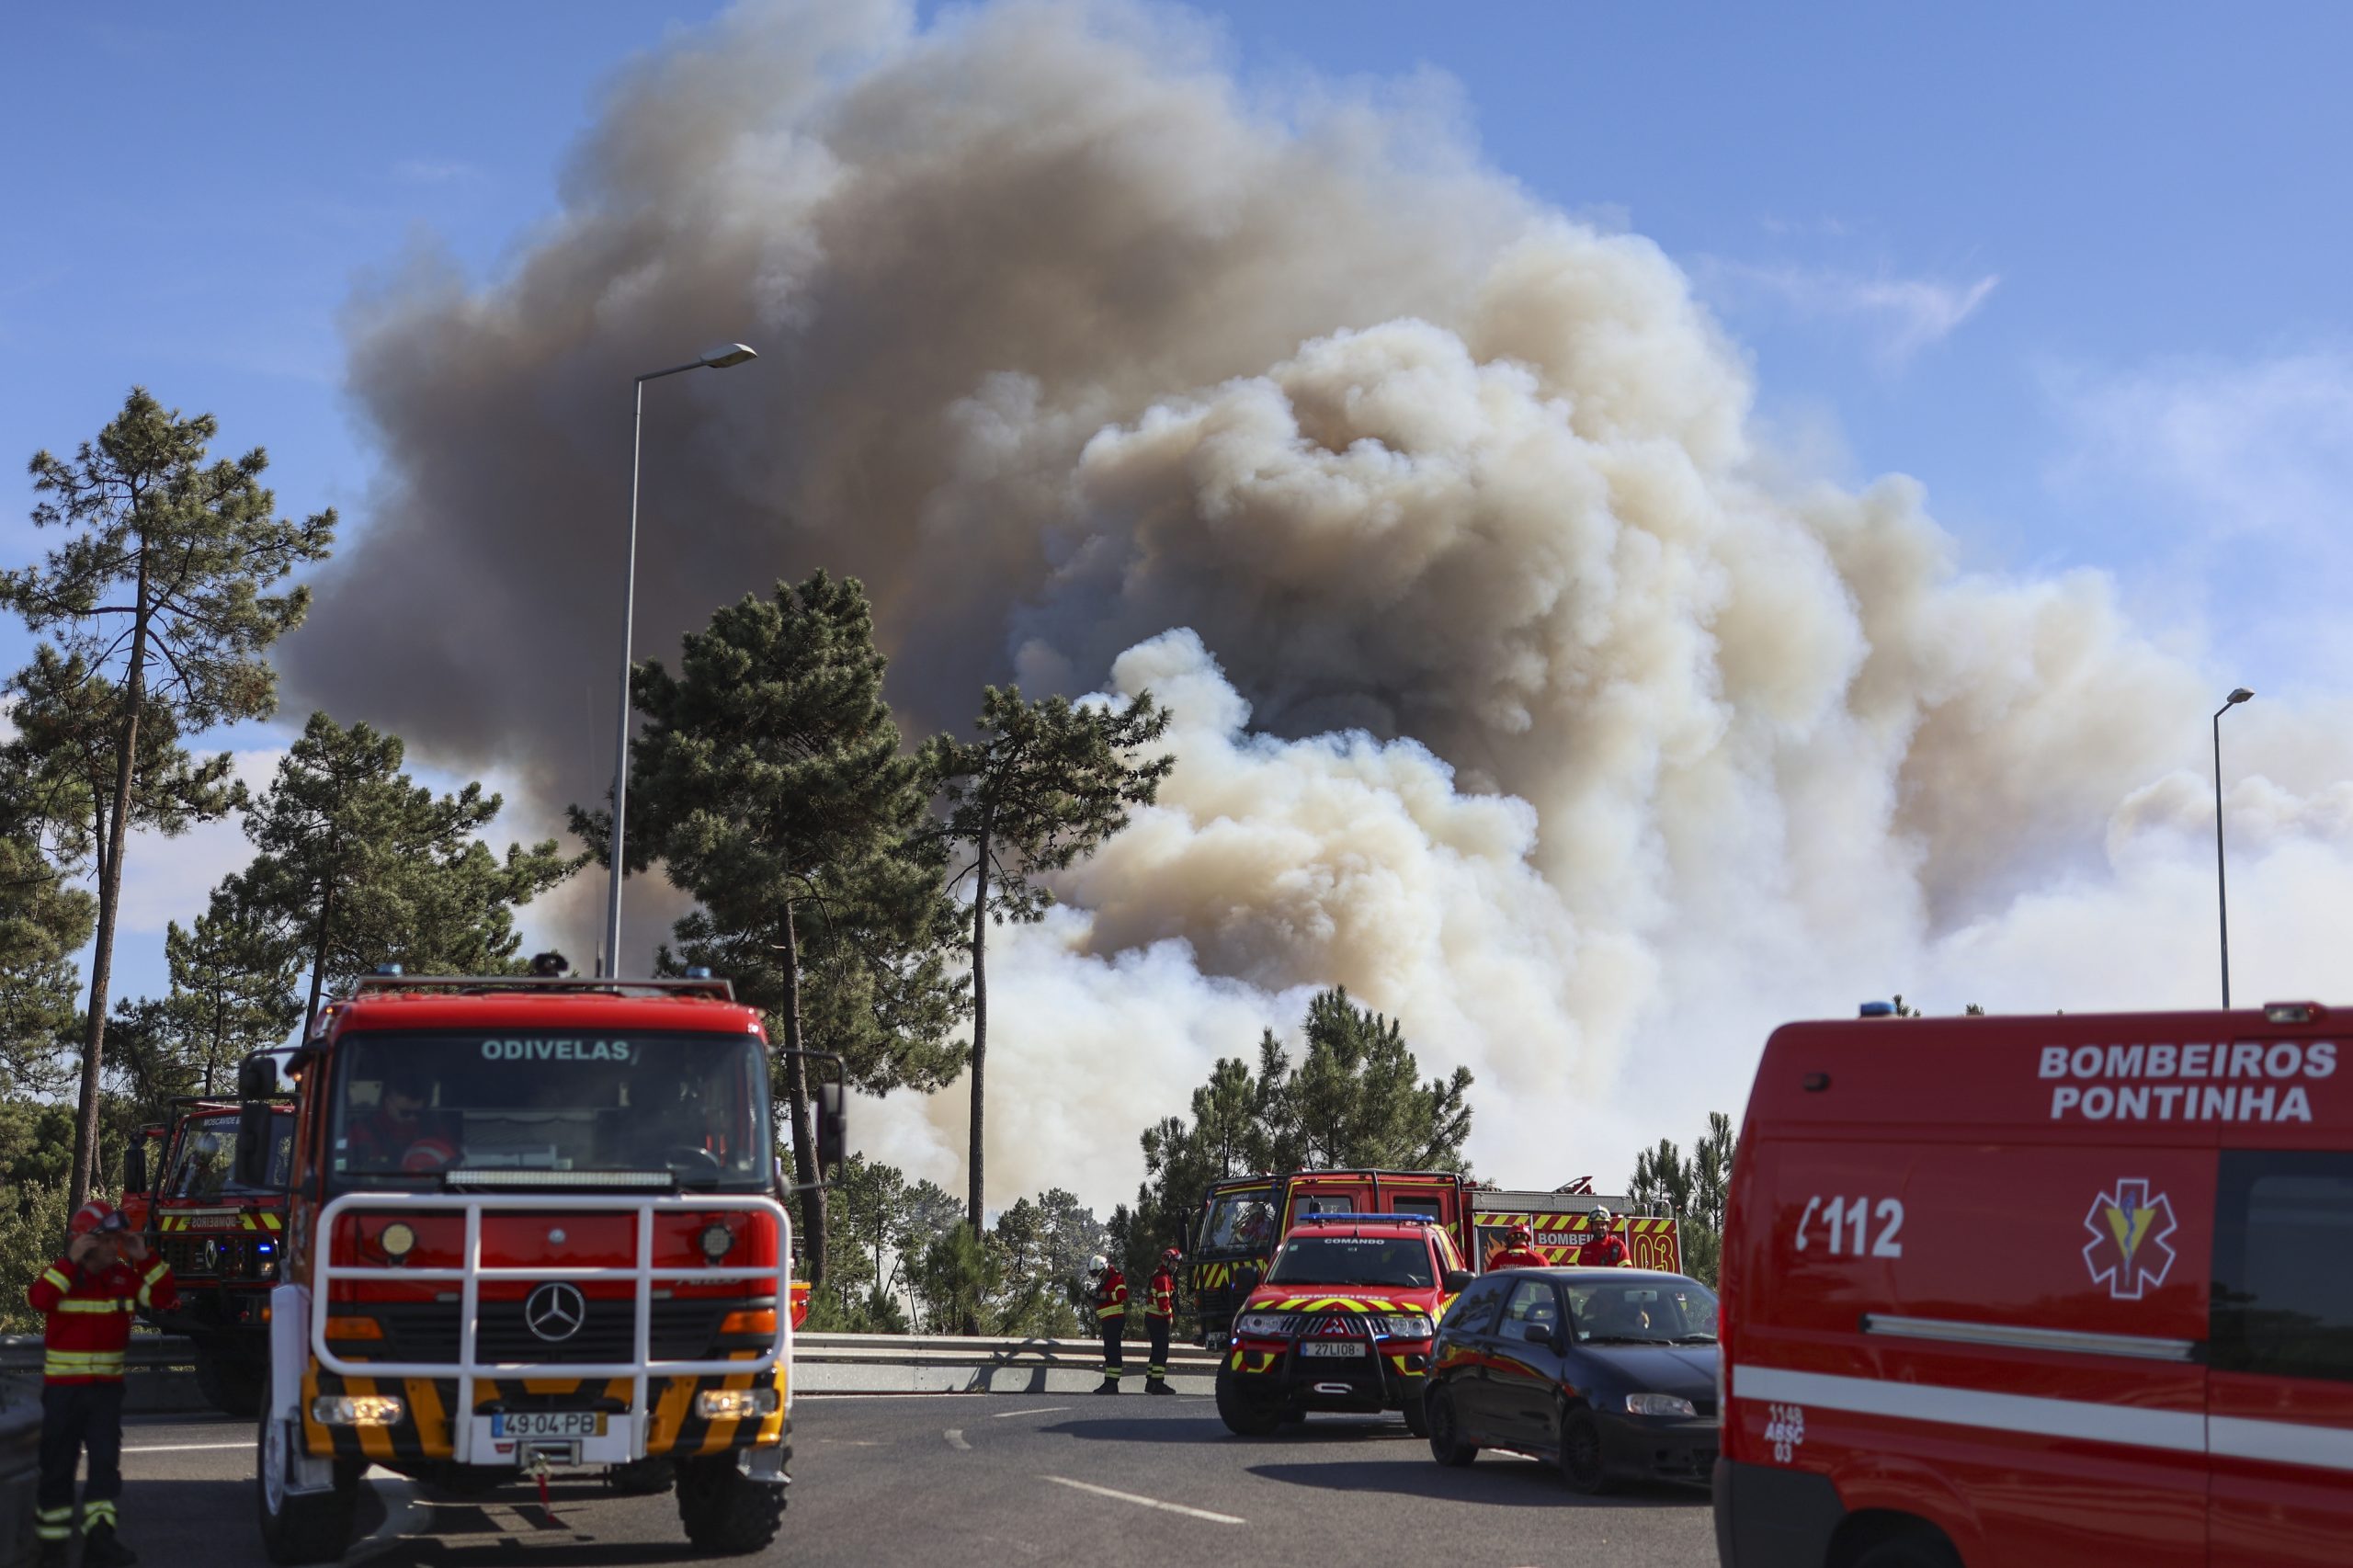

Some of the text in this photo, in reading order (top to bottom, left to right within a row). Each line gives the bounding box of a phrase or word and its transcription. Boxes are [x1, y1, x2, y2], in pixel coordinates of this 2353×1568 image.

[481, 1040, 630, 1060] ODIVELAS
[2038, 1042, 2337, 1078] BOMBEIROS
[2050, 1085, 2312, 1122] PONTINHA
[1822, 1196, 1904, 1258] 112
[1634, 1234, 1675, 1274] 03
[1315, 1343, 1356, 1356] 27LI08
[505, 1414, 595, 1434] 49-04-PB
[1764, 1422, 1804, 1445] ABSC
[1774, 1441, 1791, 1463] 03
